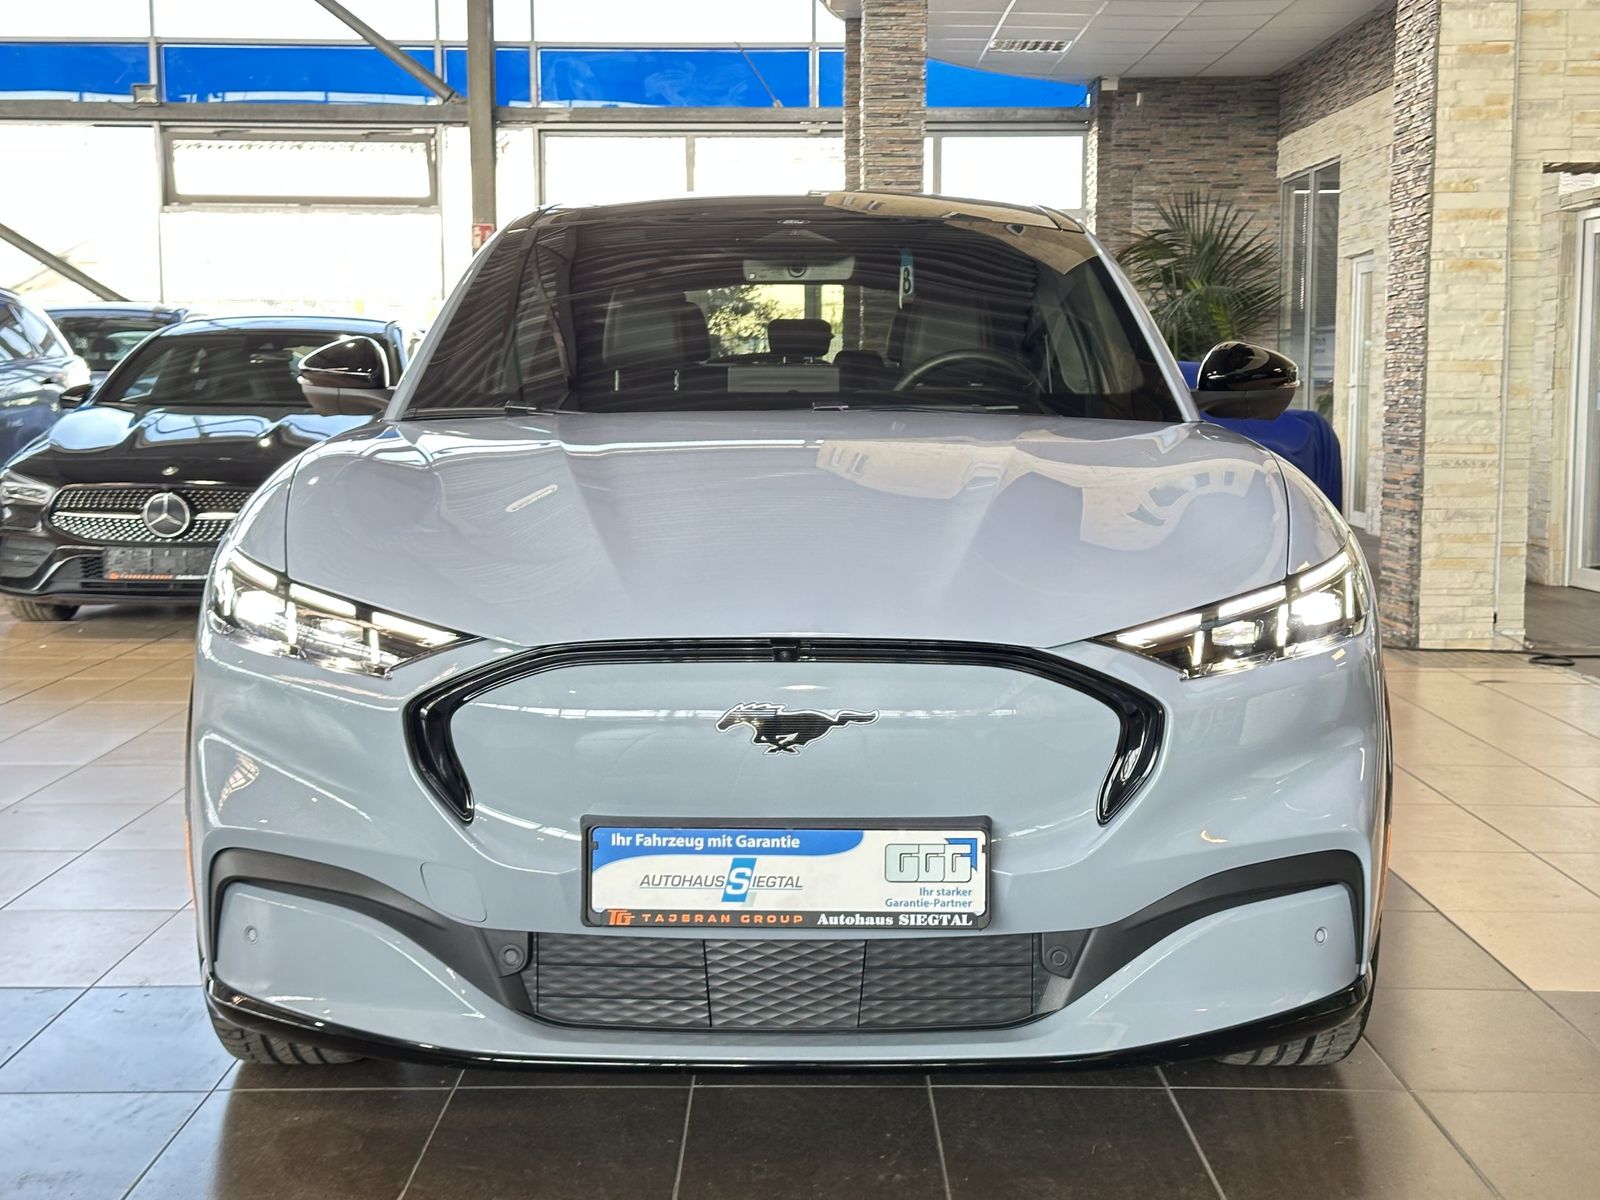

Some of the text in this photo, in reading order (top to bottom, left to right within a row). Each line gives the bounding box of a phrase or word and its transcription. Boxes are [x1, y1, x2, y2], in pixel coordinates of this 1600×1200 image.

[611, 833, 800, 850] Ihr Fahrzeug mit Garantie
[640, 874, 725, 888] AUTOHAUS
[919, 887, 972, 897] Ihr starker
[885, 898, 972, 908] Garantie-Partner
[641, 913, 731, 924] TAJERAN
[740, 914, 804, 924] GROUP
[817, 914, 973, 926] Autohaus SIEGTAL
